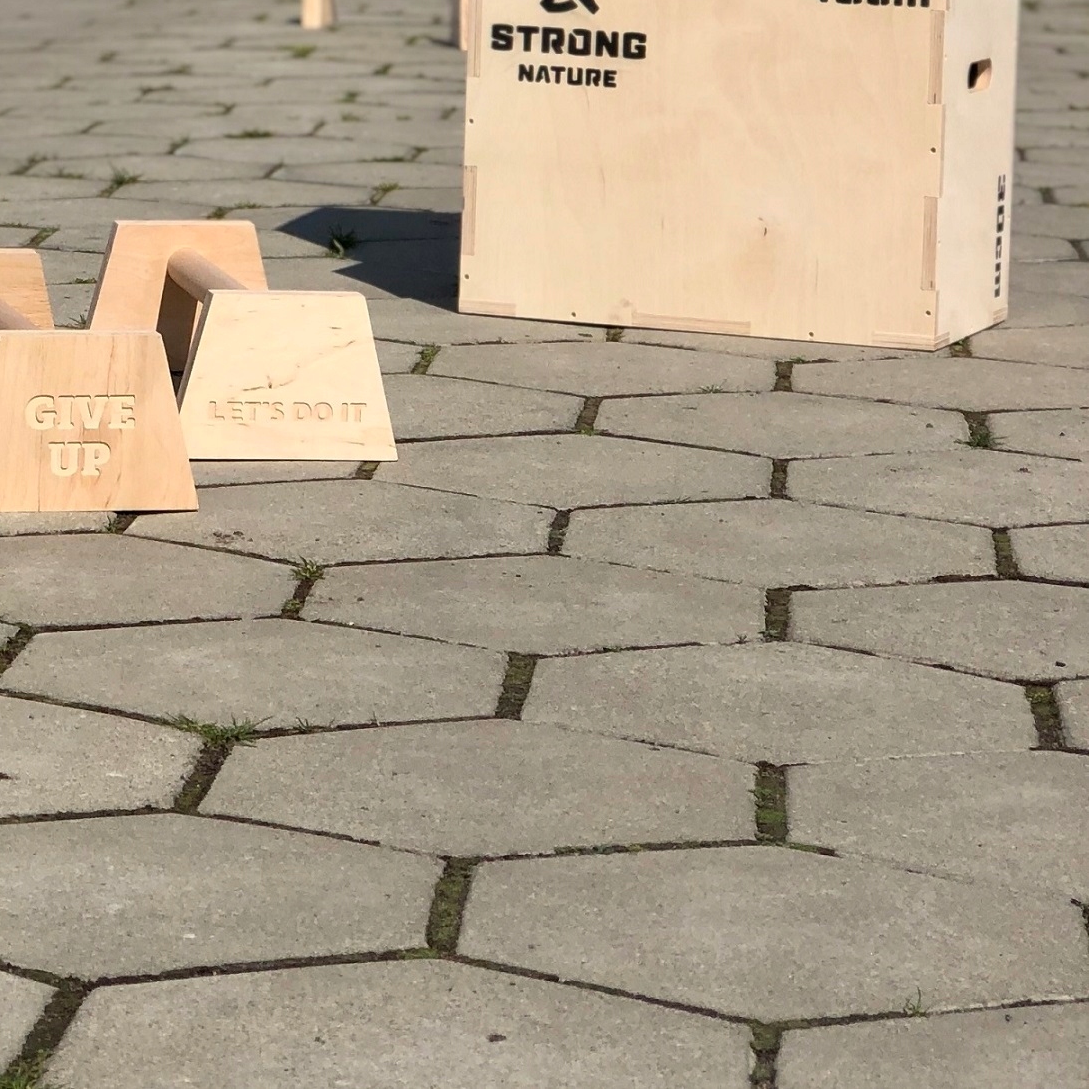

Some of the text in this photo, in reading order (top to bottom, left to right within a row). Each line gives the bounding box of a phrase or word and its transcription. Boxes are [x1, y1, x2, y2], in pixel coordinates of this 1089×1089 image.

[491, 23, 647, 60] STRONG
[518, 64, 618, 88] NATURE
[25, 395, 136, 430] GIVE
[208, 400, 368, 422] LET'S DO IT
[48, 441, 112, 477] UP
